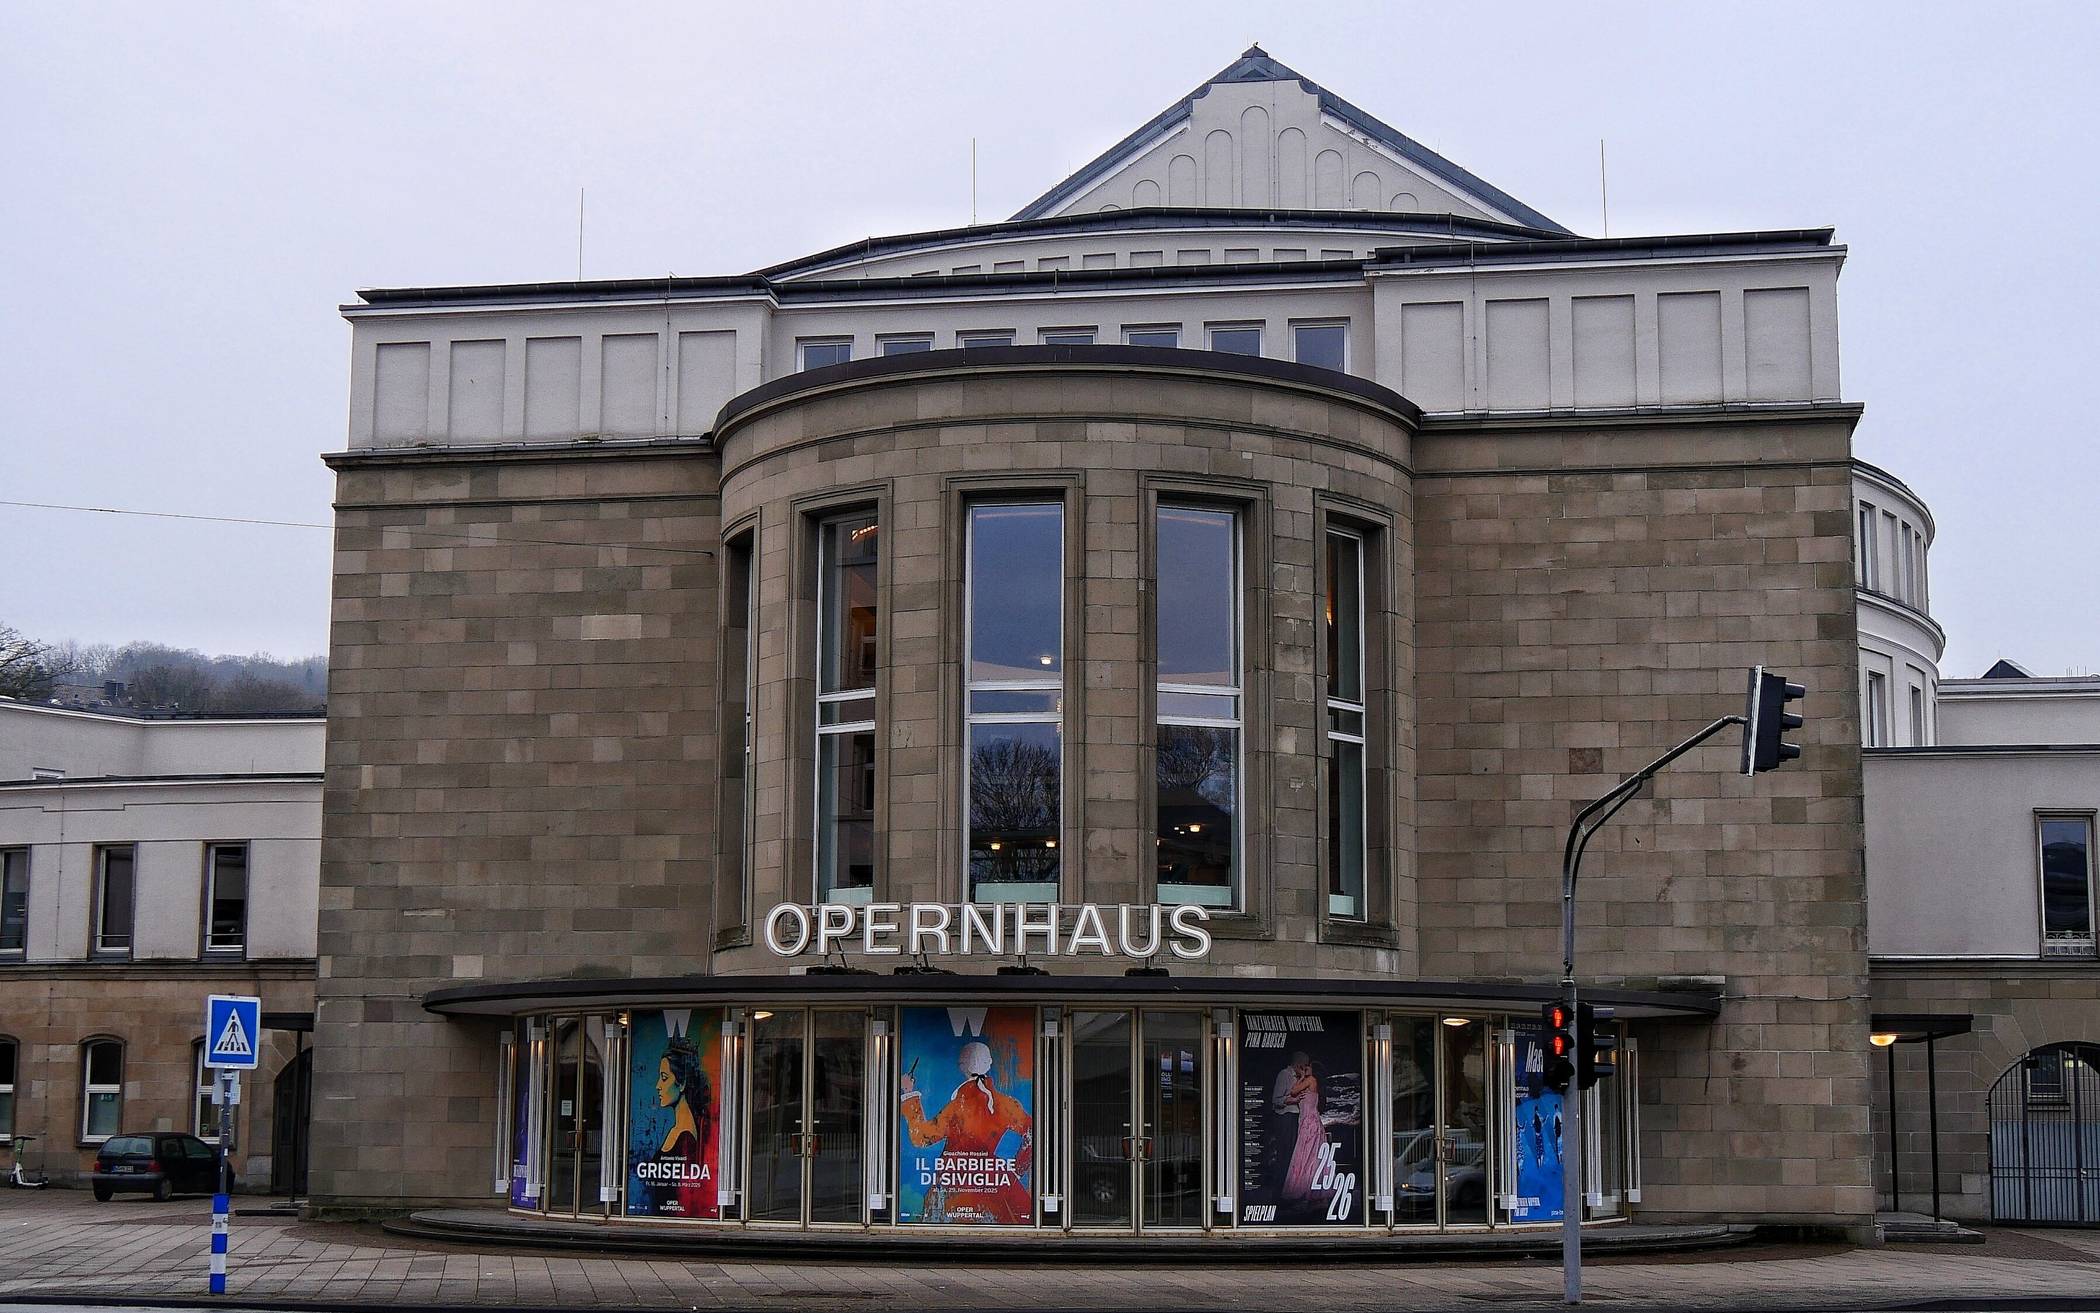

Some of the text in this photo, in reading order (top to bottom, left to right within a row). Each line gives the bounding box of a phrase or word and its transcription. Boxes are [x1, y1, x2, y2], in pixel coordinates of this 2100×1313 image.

[764, 902, 1213, 959] OPERNHAUS
[1244, 1015, 1325, 1031] TANZTHEATER WUPPERTAL
[1245, 1032, 1287, 1048] PINA BAUSCH
[637, 1162, 711, 1180] GRISELDA
[915, 1158, 1017, 1172] IL BARBIERE
[1311, 1142, 1342, 1190] 25
[920, 1172, 1011, 1186] DI SIVIGLIA
[1326, 1172, 1356, 1221] 26
[1244, 1205, 1277, 1221] SPIELPLAN
